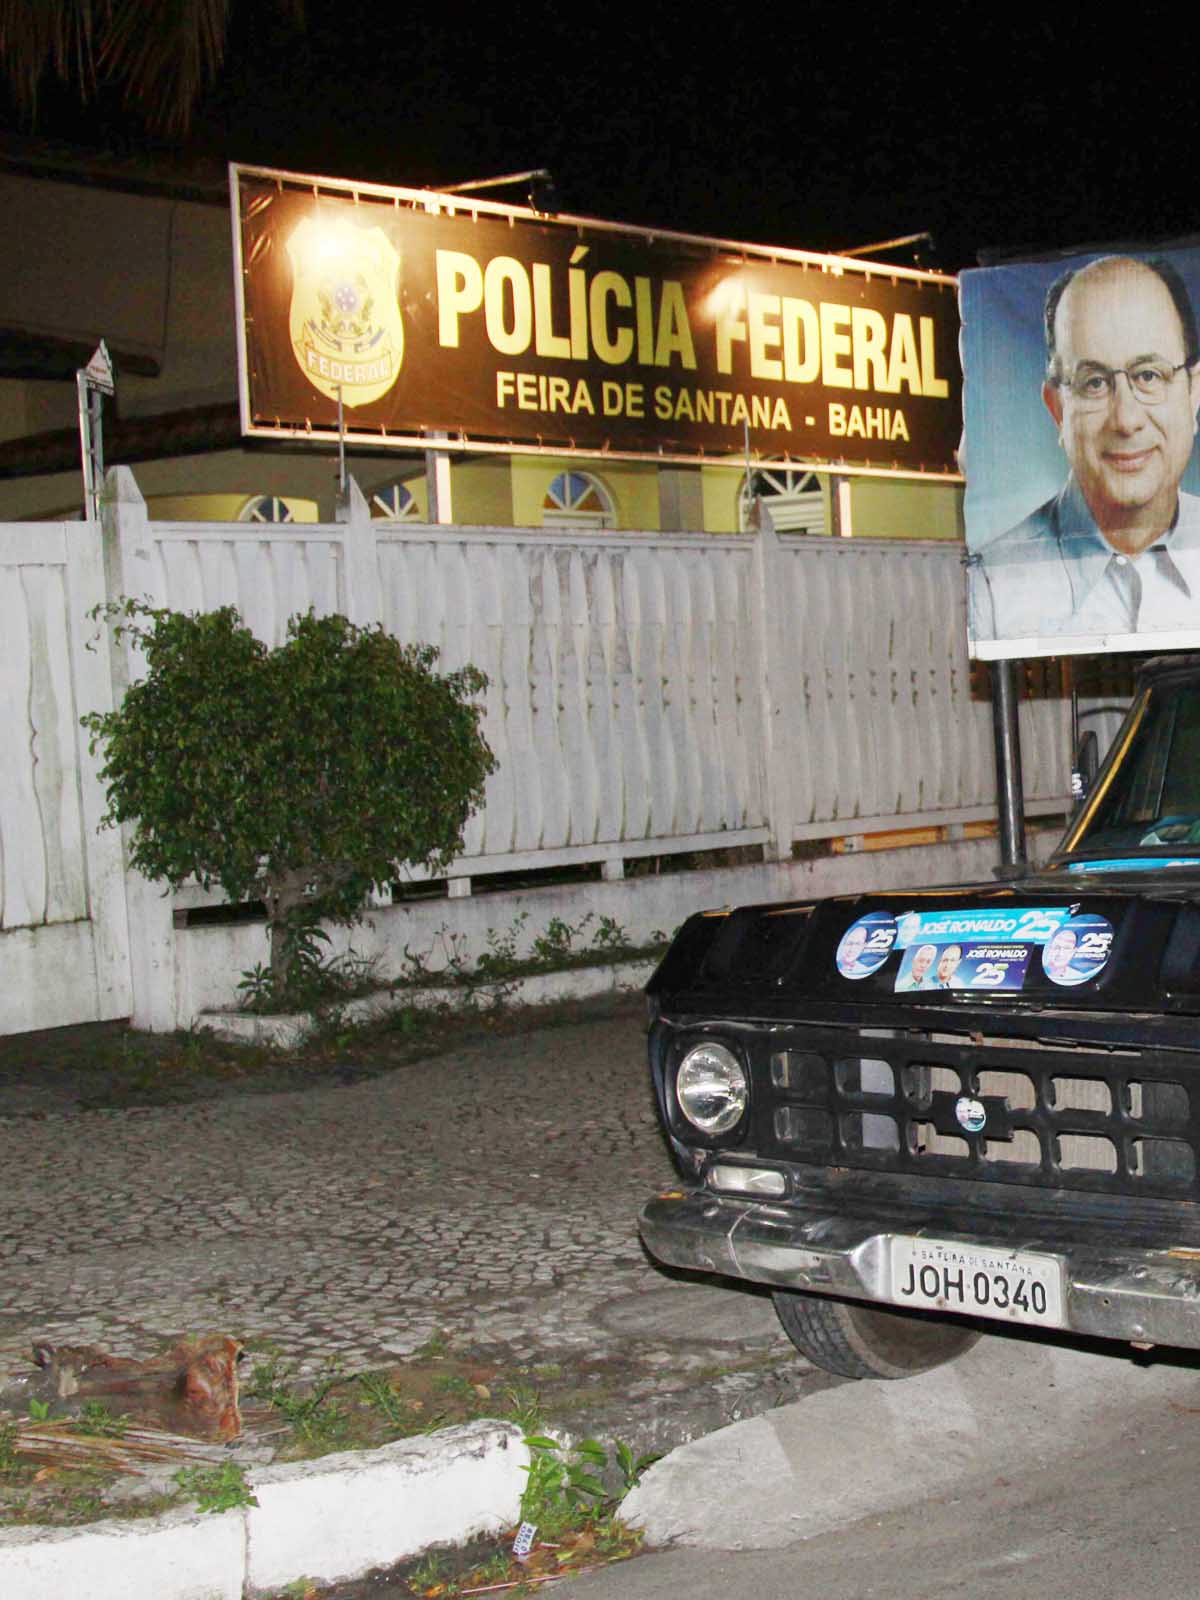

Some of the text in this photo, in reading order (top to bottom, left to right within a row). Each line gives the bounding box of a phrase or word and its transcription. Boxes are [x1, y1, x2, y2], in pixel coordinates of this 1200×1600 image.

[436, 246, 949, 398] POLÍCIA FEDERAL
[496, 371, 594, 415] FEIRA
[602, 382, 645, 418] DE
[655, 386, 792, 431] SANTANA
[828, 403, 910, 441] BAHIA
[948, 919, 1017, 933] RONALDO
[1011, 911, 1066, 939] 25
[865, 929, 897, 948] 25
[1076, 932, 1114, 953] 25
[970, 962, 1009, 985] 25
[901, 1263, 1046, 1314] JOH 0340
